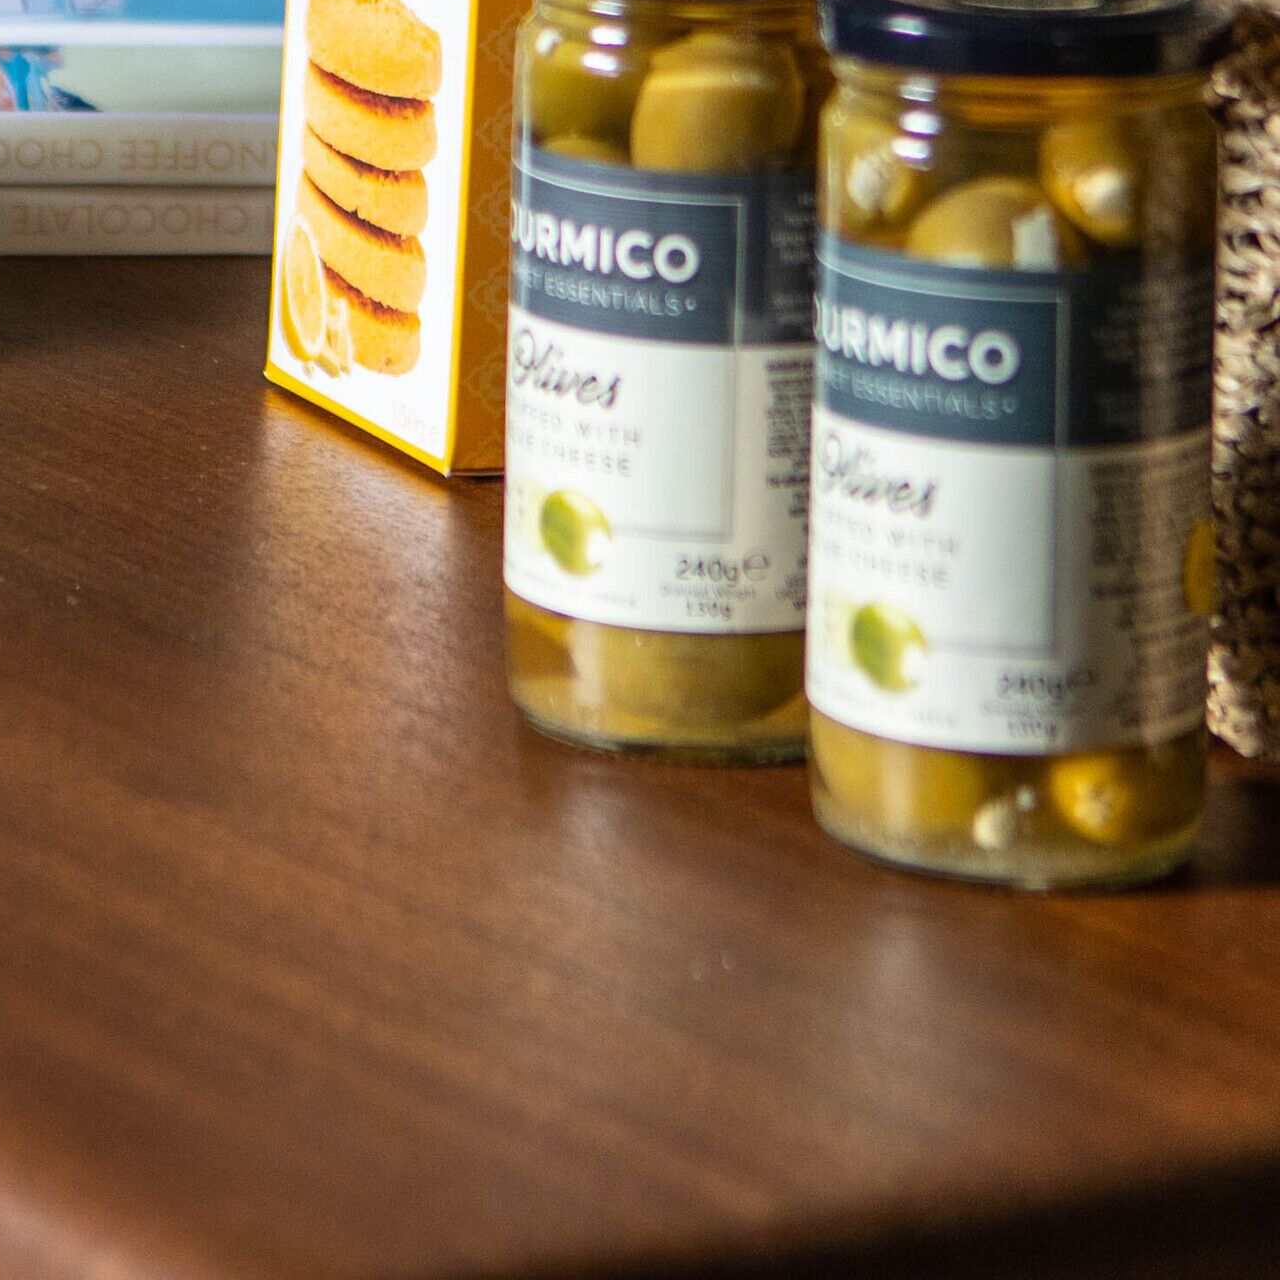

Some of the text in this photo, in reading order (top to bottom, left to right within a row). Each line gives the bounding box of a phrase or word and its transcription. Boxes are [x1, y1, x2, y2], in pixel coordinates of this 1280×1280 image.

[121, 137, 283, 171] NOFFEE
[11, 203, 251, 237] CHOCOLATE
[511, 328, 622, 410] Olives
[819, 432, 938, 519] Olives
